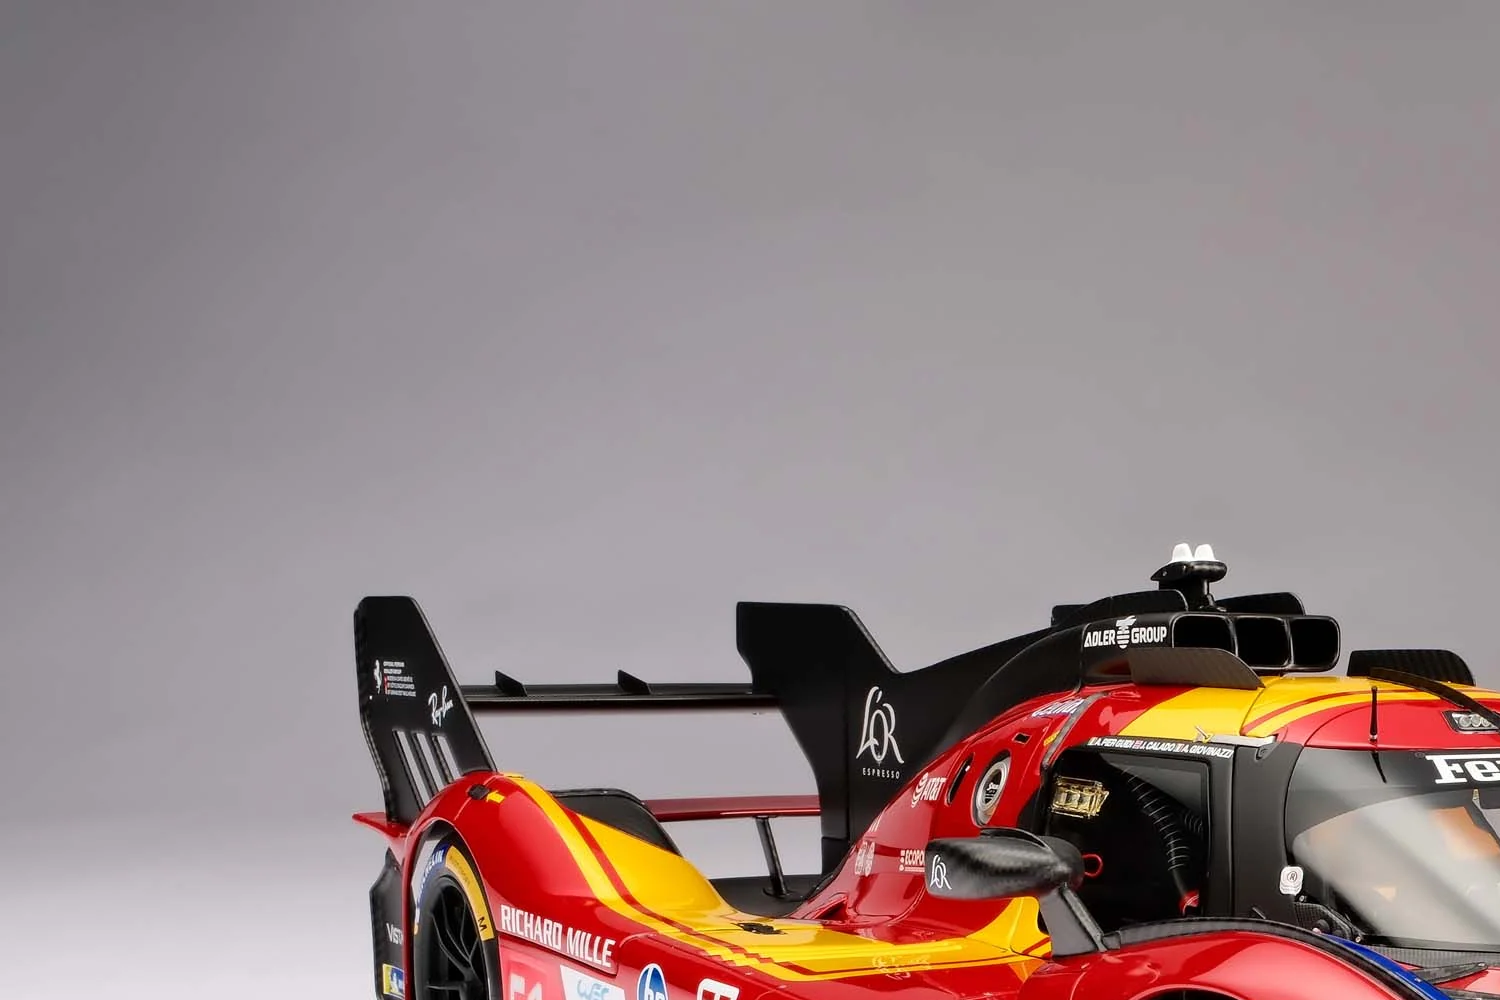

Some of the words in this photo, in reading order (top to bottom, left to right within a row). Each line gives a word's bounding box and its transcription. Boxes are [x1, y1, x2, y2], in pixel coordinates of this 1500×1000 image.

[1084, 629, 1116, 648] ADLER
[1131, 626, 1167, 644] GROUP
[1146, 741, 1175, 752] CALADO
[862, 767, 900, 779] ESPRESSO
[904, 848, 925, 866] ECOPO
[500, 904, 562, 949] RICHARD
[566, 928, 616, 968] MILLE
